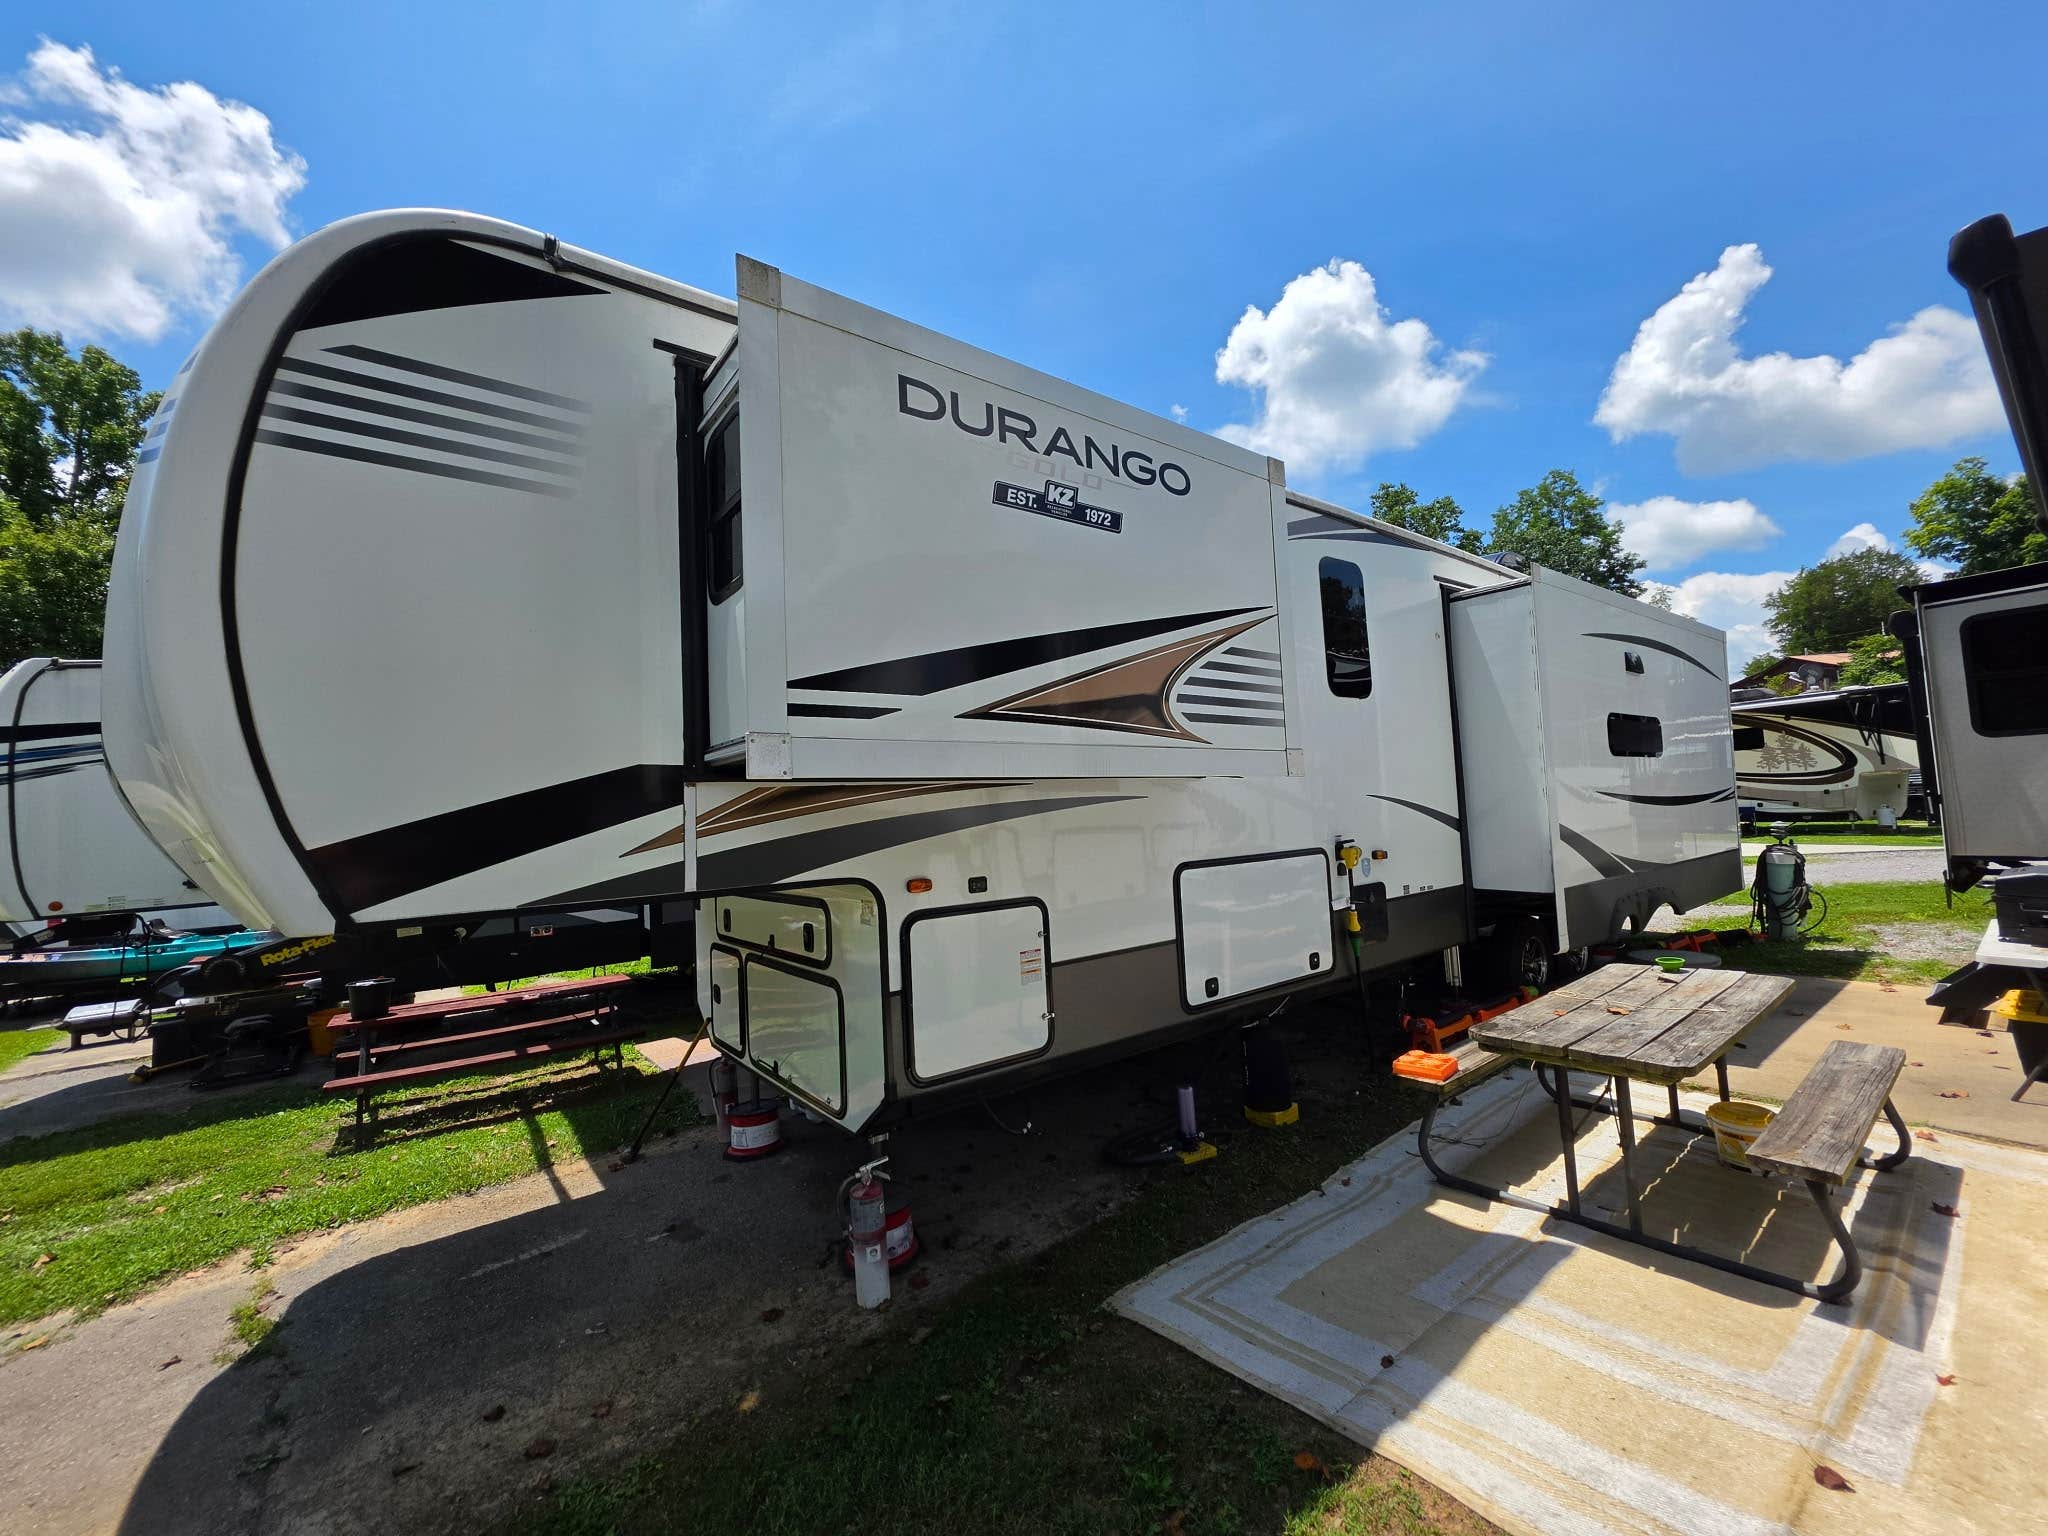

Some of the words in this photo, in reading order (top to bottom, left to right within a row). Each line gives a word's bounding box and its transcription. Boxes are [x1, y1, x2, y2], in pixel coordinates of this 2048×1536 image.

[898, 373, 1191, 497] DURANGO
[1007, 488, 1037, 509] EST.
[1047, 484, 1075, 507] KZ
[1084, 508, 1112, 526] 1972
